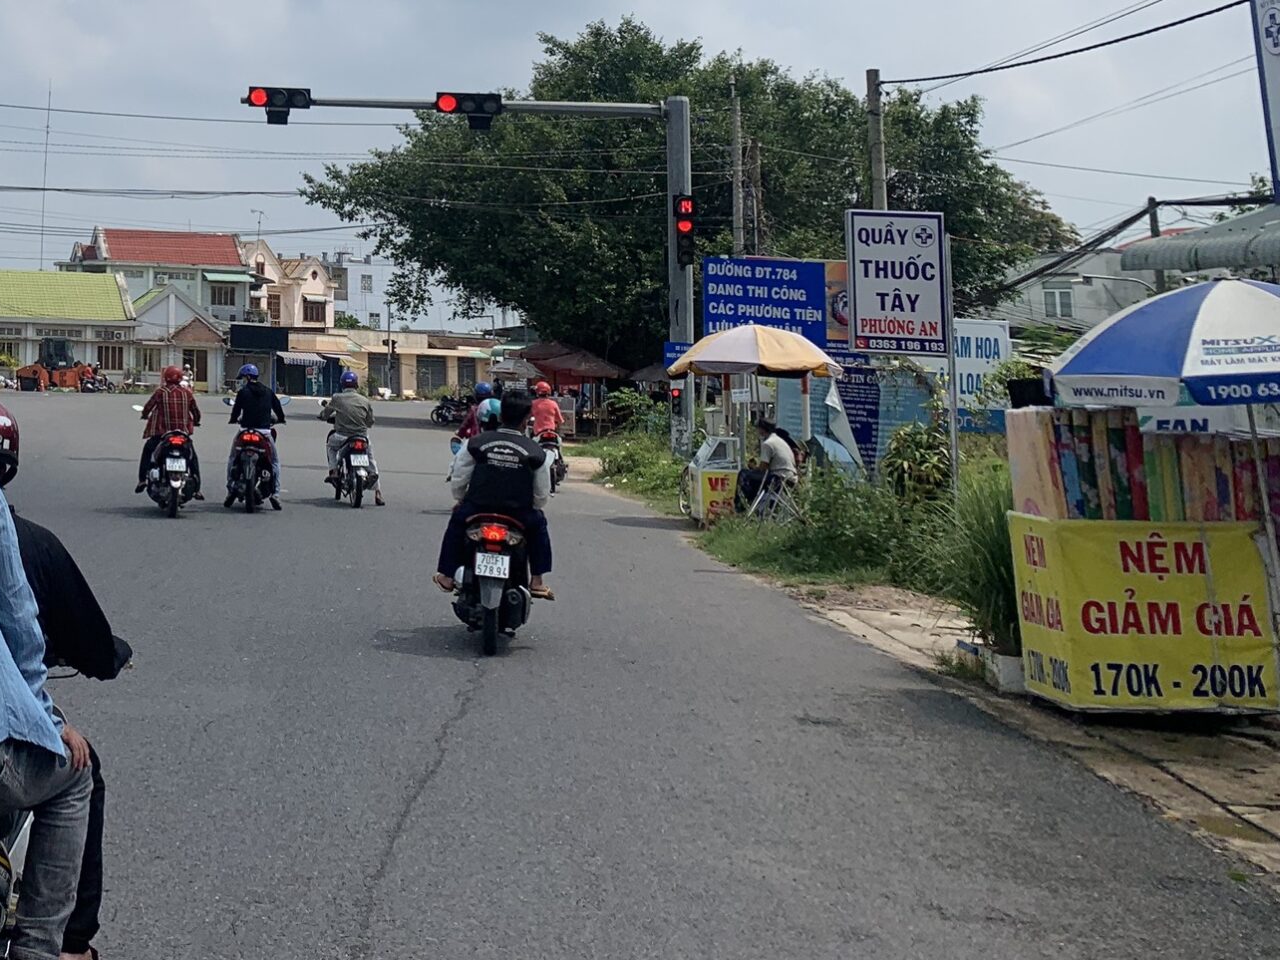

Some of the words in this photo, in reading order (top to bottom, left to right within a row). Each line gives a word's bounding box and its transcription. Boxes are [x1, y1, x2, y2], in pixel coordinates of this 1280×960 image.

[681, 200, 692, 213] 14
[857, 221, 908, 246] QUẦY
[708, 260, 752, 278] ĐƯỜNG
[755, 266, 797, 281] ĐT.784
[859, 254, 935, 281] THUỐC
[708, 283, 743, 296] ĐANG
[746, 285, 768, 298] THI
[771, 285, 807, 301] CÔNG
[876, 288, 919, 313] TÂY
[708, 300, 735, 315] CÁC
[737, 304, 790, 320] PHƯƠNG
[794, 307, 822, 324] TIỆN
[860, 316, 915, 335] PHƯƠNG
[919, 320, 938, 336] AN
[869, 339, 897, 350] 0363
[900, 340, 921, 351] 196
[924, 341, 945, 352] 193
[1225, 357, 1245, 365] LÀM
[1072, 385, 1165, 400] www.mitsu.vn
[1206, 383, 1252, 400] 1900
[1120, 531, 1207, 581] NỆM
[1081, 588, 1182, 636] GIẢM
[1196, 594, 1263, 638] GIÁ
[1090, 663, 1164, 698] 170K
[1192, 664, 1267, 699] 200K
